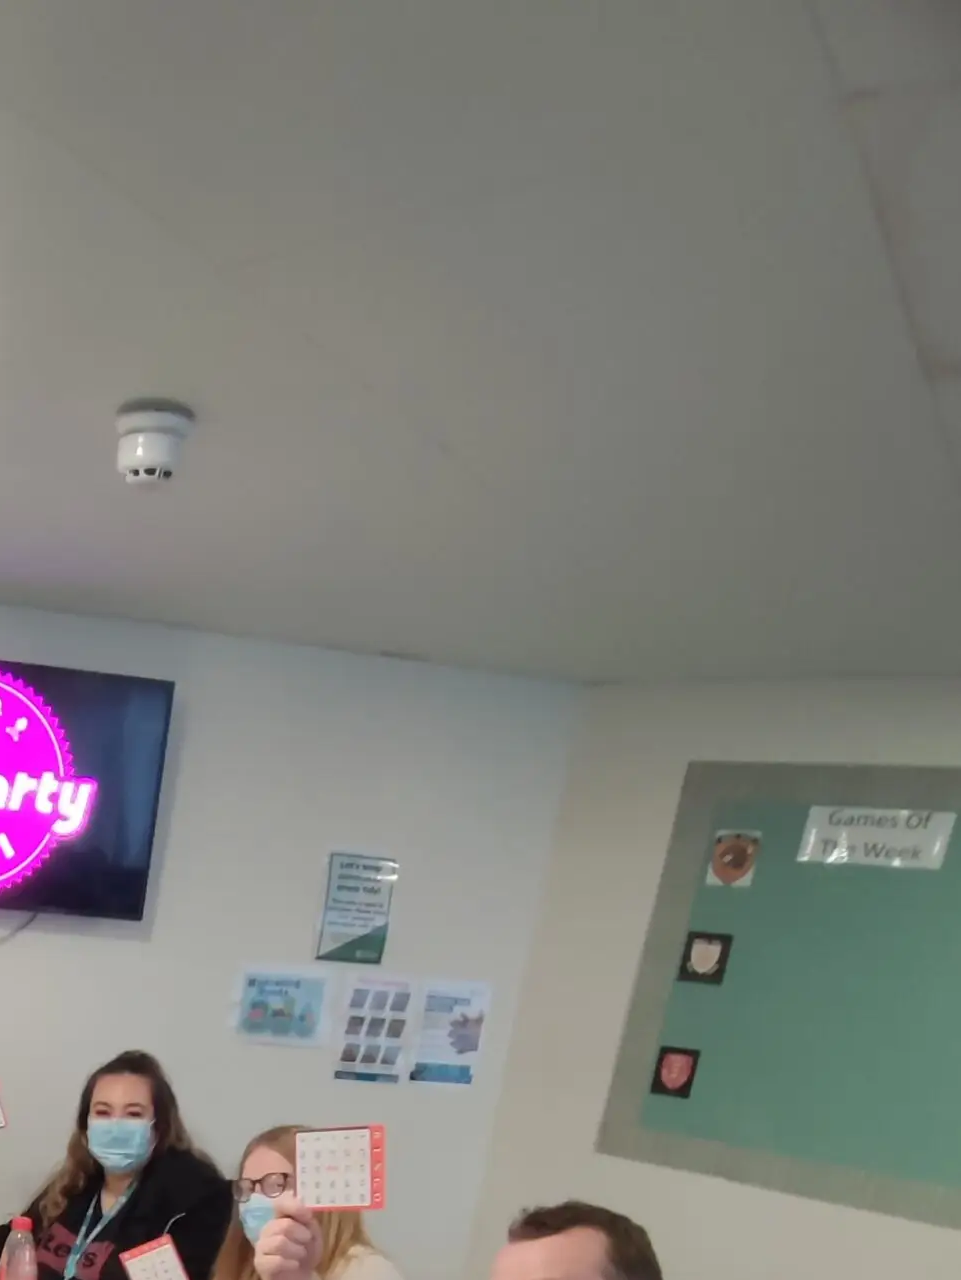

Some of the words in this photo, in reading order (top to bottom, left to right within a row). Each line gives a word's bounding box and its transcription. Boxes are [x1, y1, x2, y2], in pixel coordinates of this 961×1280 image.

[828, 807, 898, 829] Games
[906, 810, 934, 830] Of
[864, 841, 922, 861] Week
